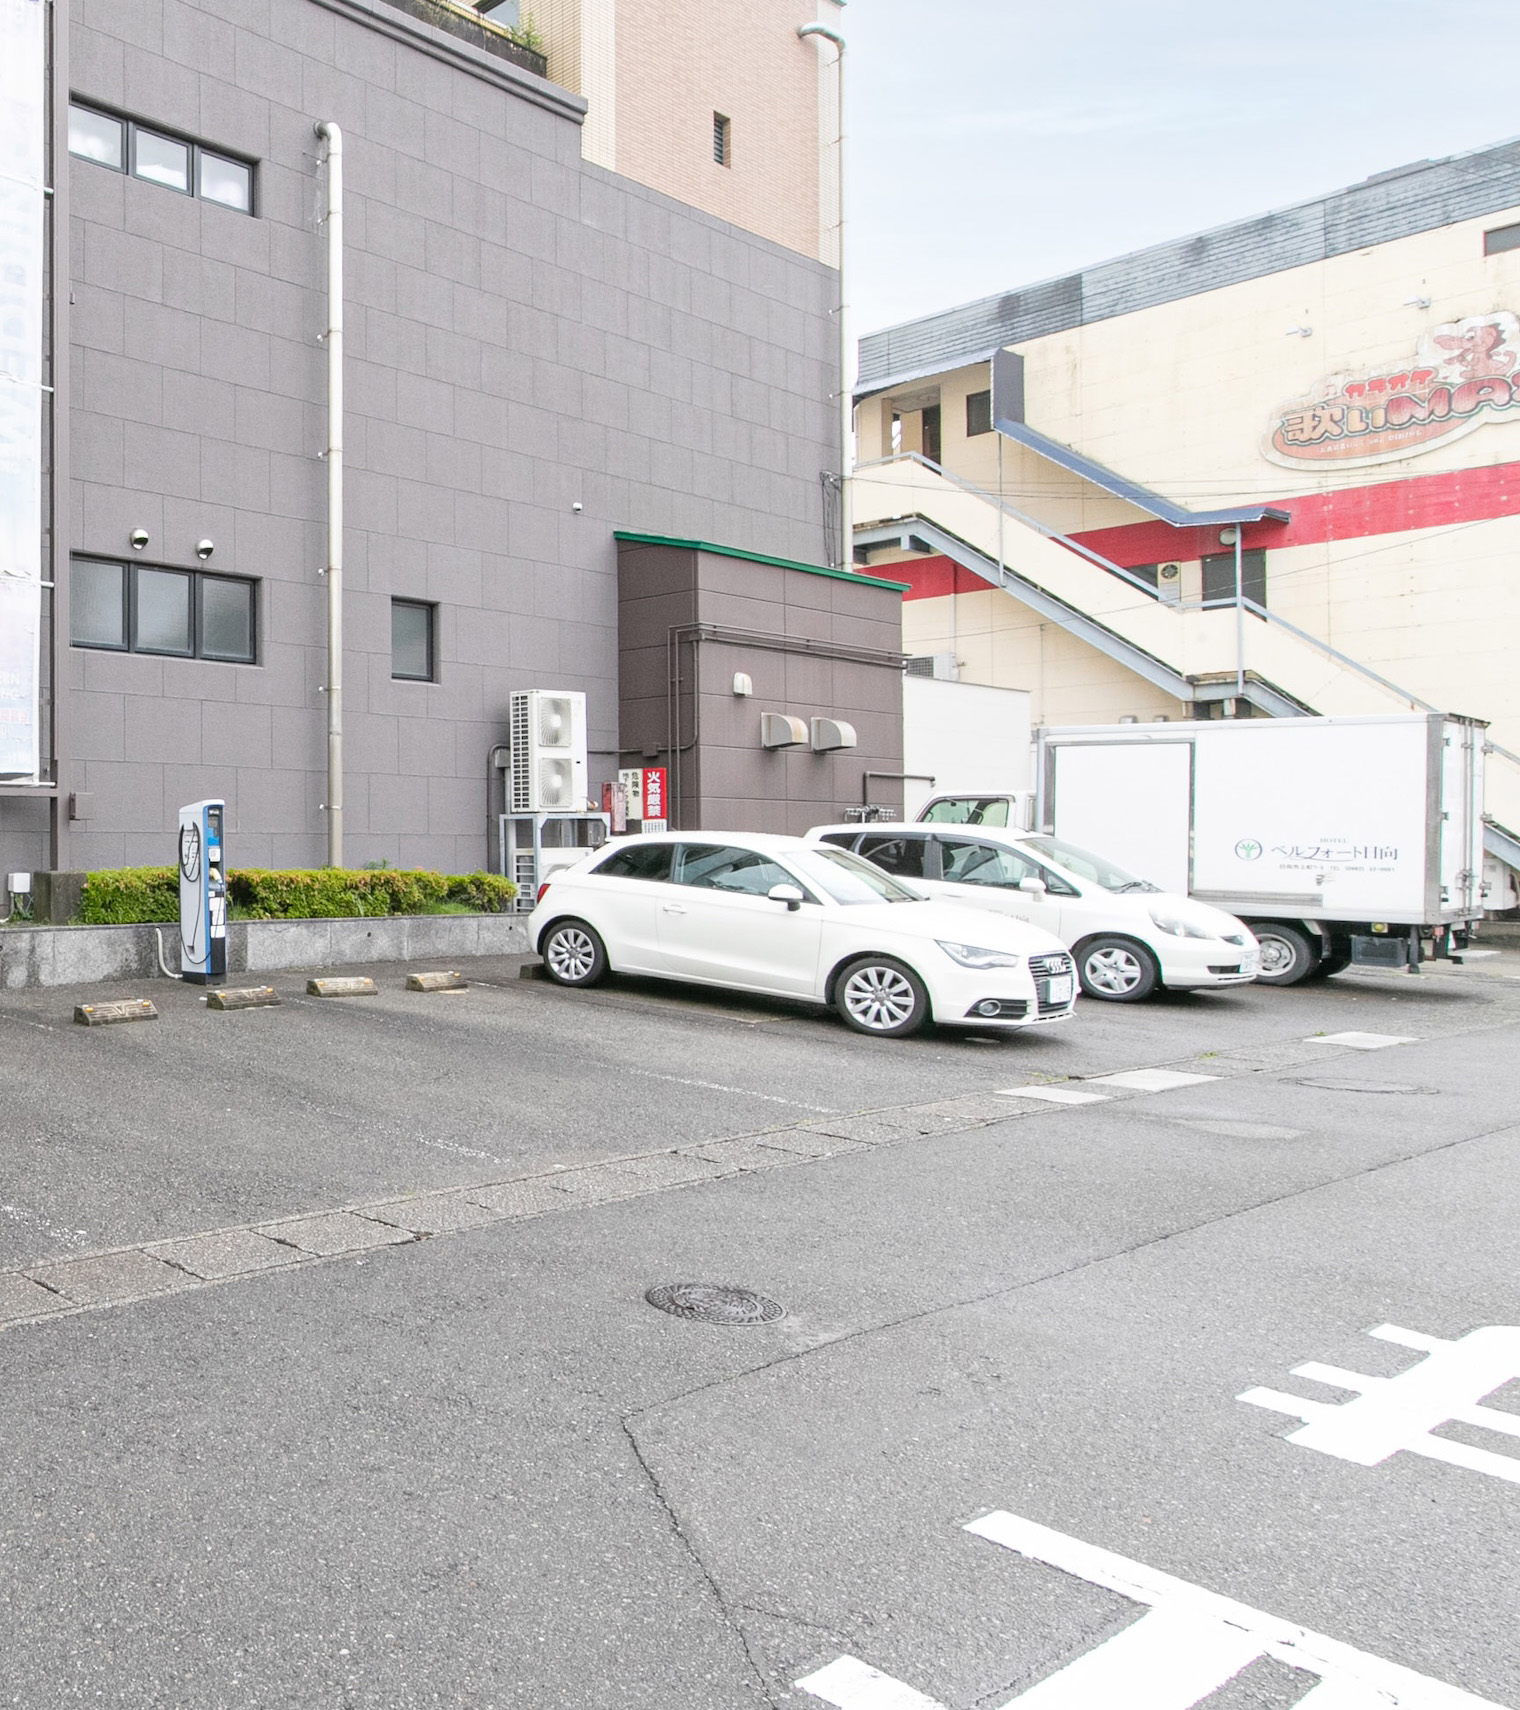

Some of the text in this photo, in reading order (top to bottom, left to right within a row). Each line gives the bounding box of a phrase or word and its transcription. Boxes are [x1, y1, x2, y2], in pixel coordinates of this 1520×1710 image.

[1344, 369, 1433, 399] カラオケ
[1270, 844, 1399, 862] ベルフォート日向
